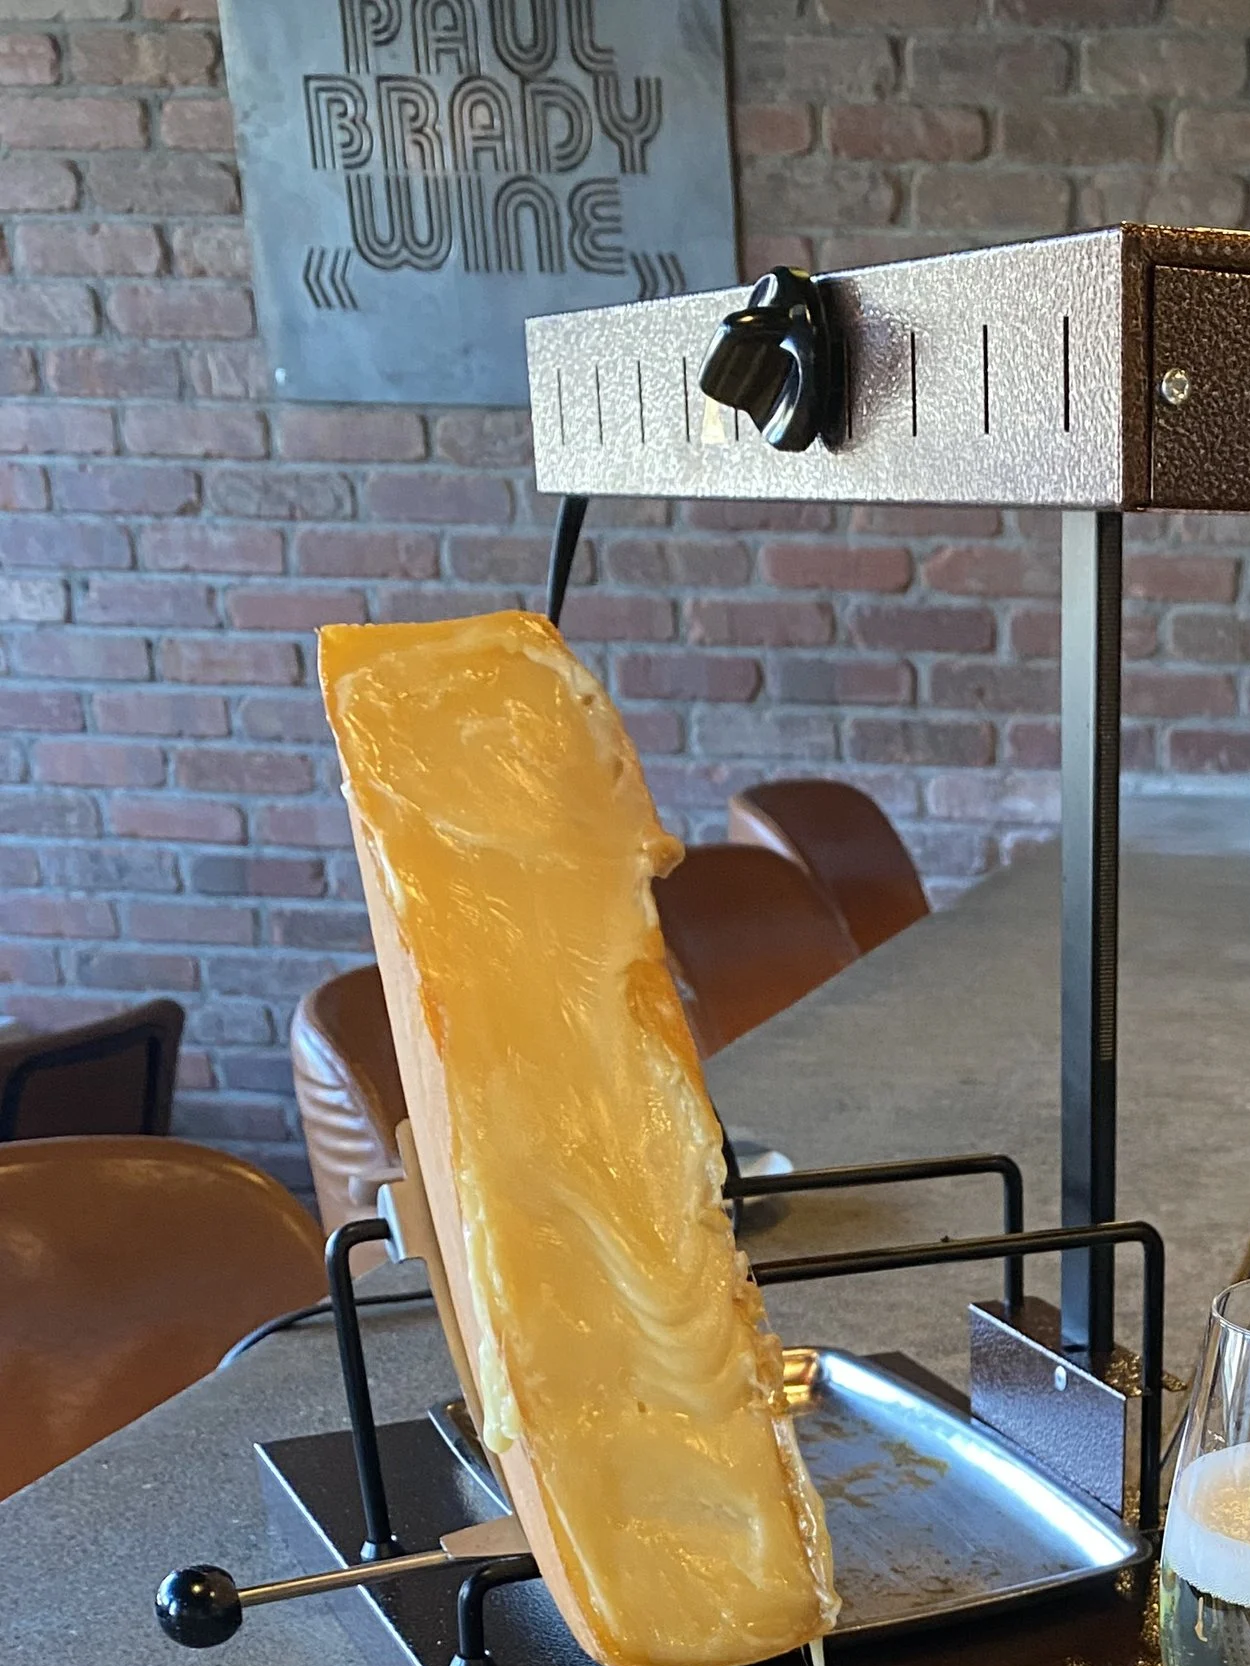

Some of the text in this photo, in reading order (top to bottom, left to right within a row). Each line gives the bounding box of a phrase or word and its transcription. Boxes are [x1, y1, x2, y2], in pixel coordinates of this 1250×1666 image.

[338, 0, 616, 76] PAUL
[302, 73, 662, 174] BRADY
[345, 173, 627, 275] WINE
